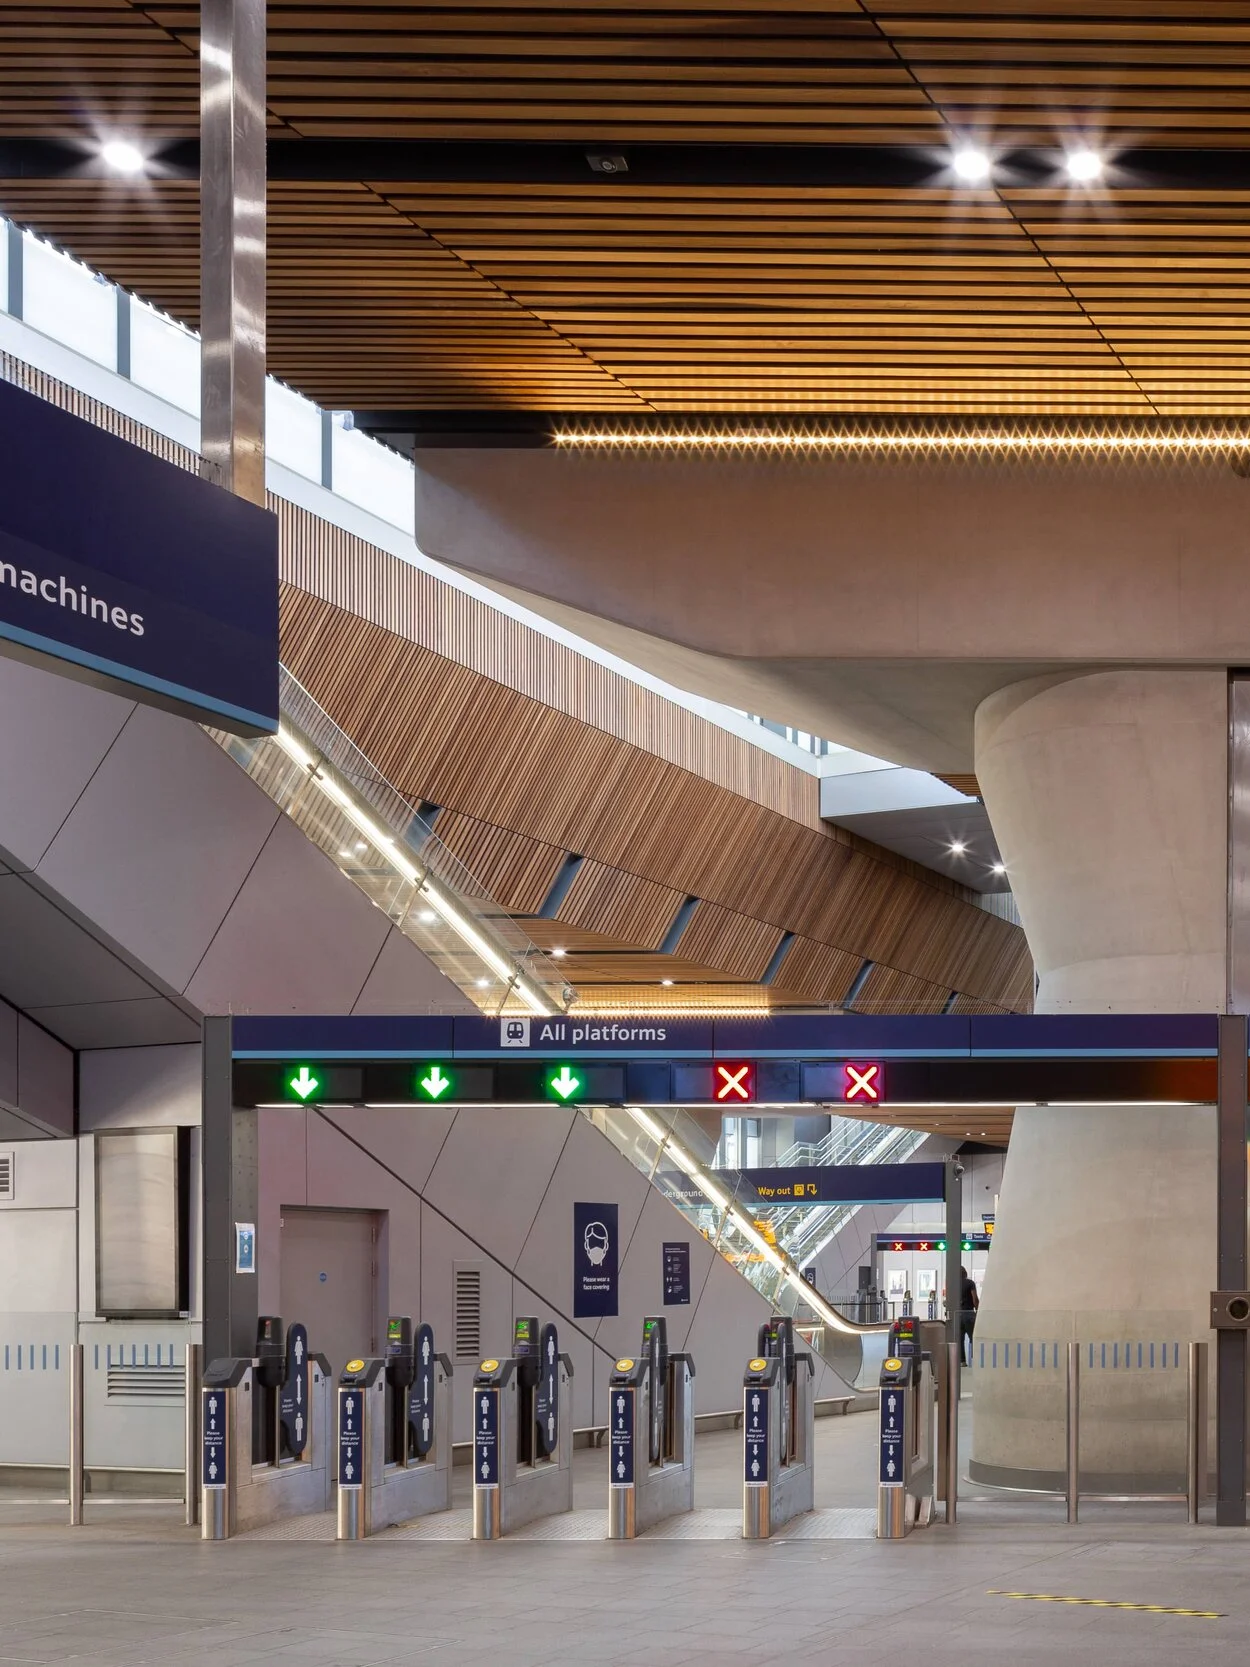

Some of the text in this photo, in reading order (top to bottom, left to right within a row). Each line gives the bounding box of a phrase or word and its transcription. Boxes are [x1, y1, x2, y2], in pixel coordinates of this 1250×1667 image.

[540, 1024, 666, 1044] All platforms
[758, 1186, 790, 1196] Way out
